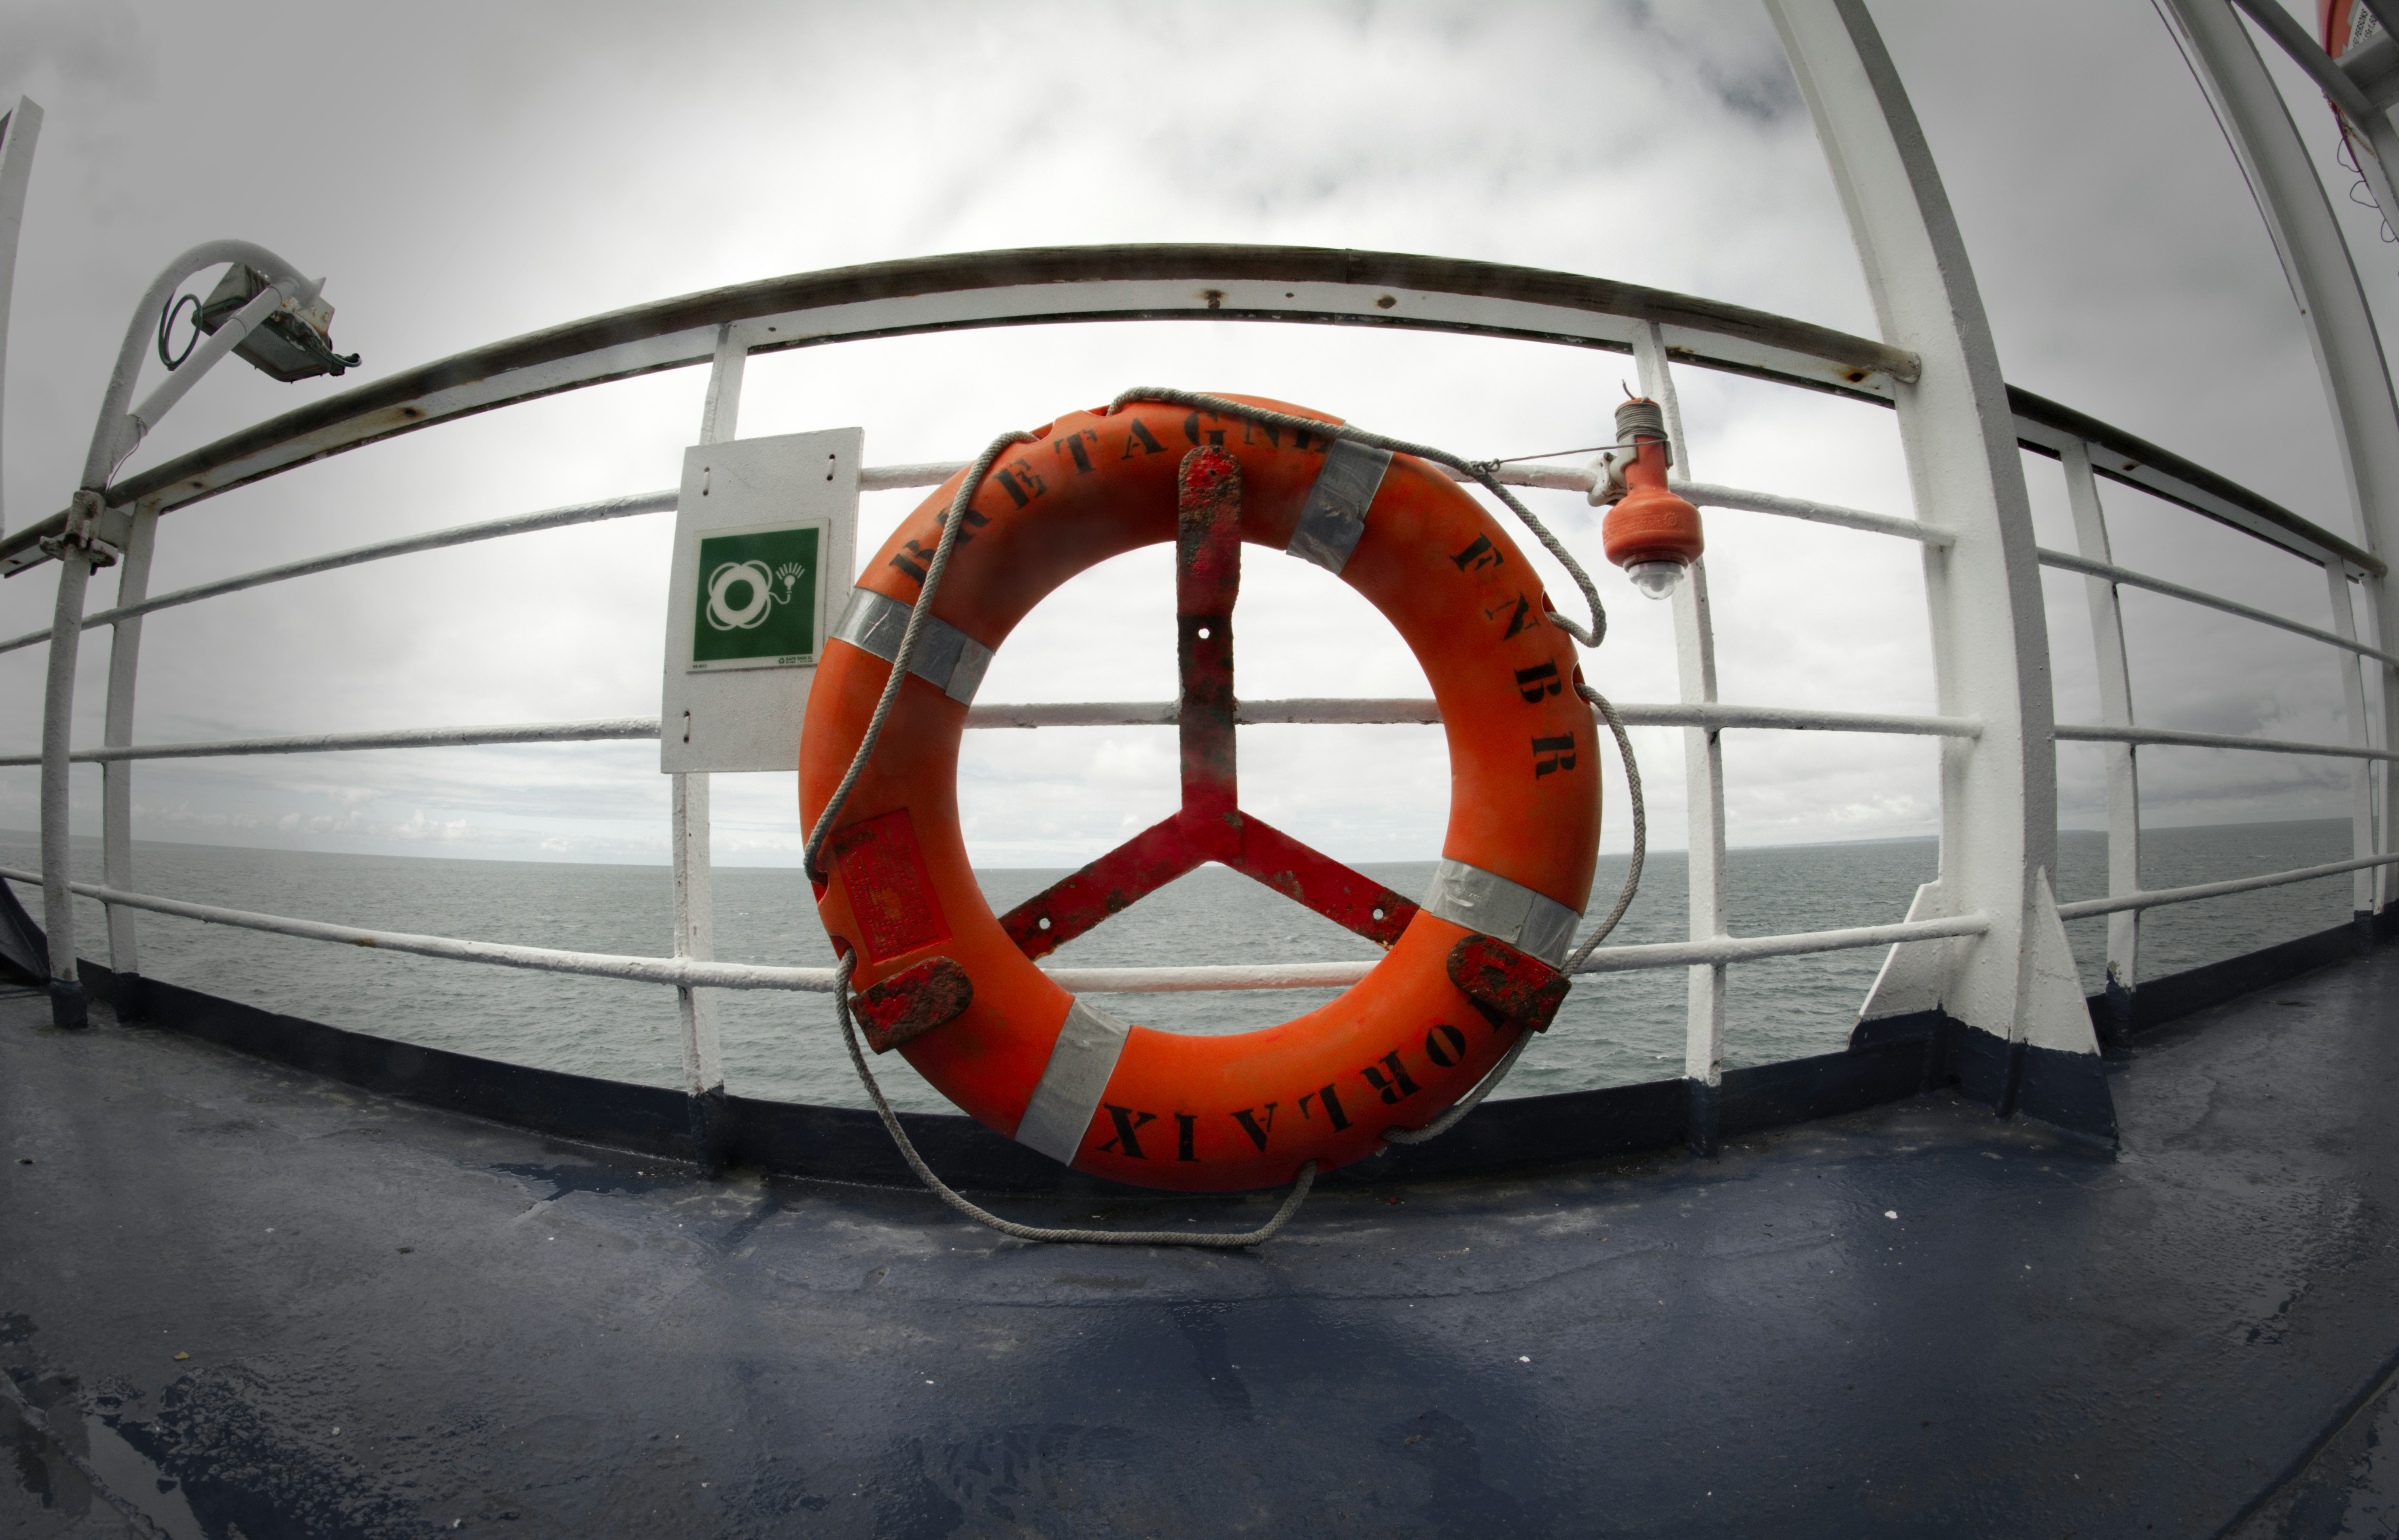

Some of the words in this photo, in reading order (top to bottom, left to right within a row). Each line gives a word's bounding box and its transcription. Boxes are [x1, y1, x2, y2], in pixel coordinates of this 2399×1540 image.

[2355, 8, 2368, 39] PERSONS
[1449, 532, 1577, 780] FNBR
[1095, 995, 1507, 1162] ORLAIX
